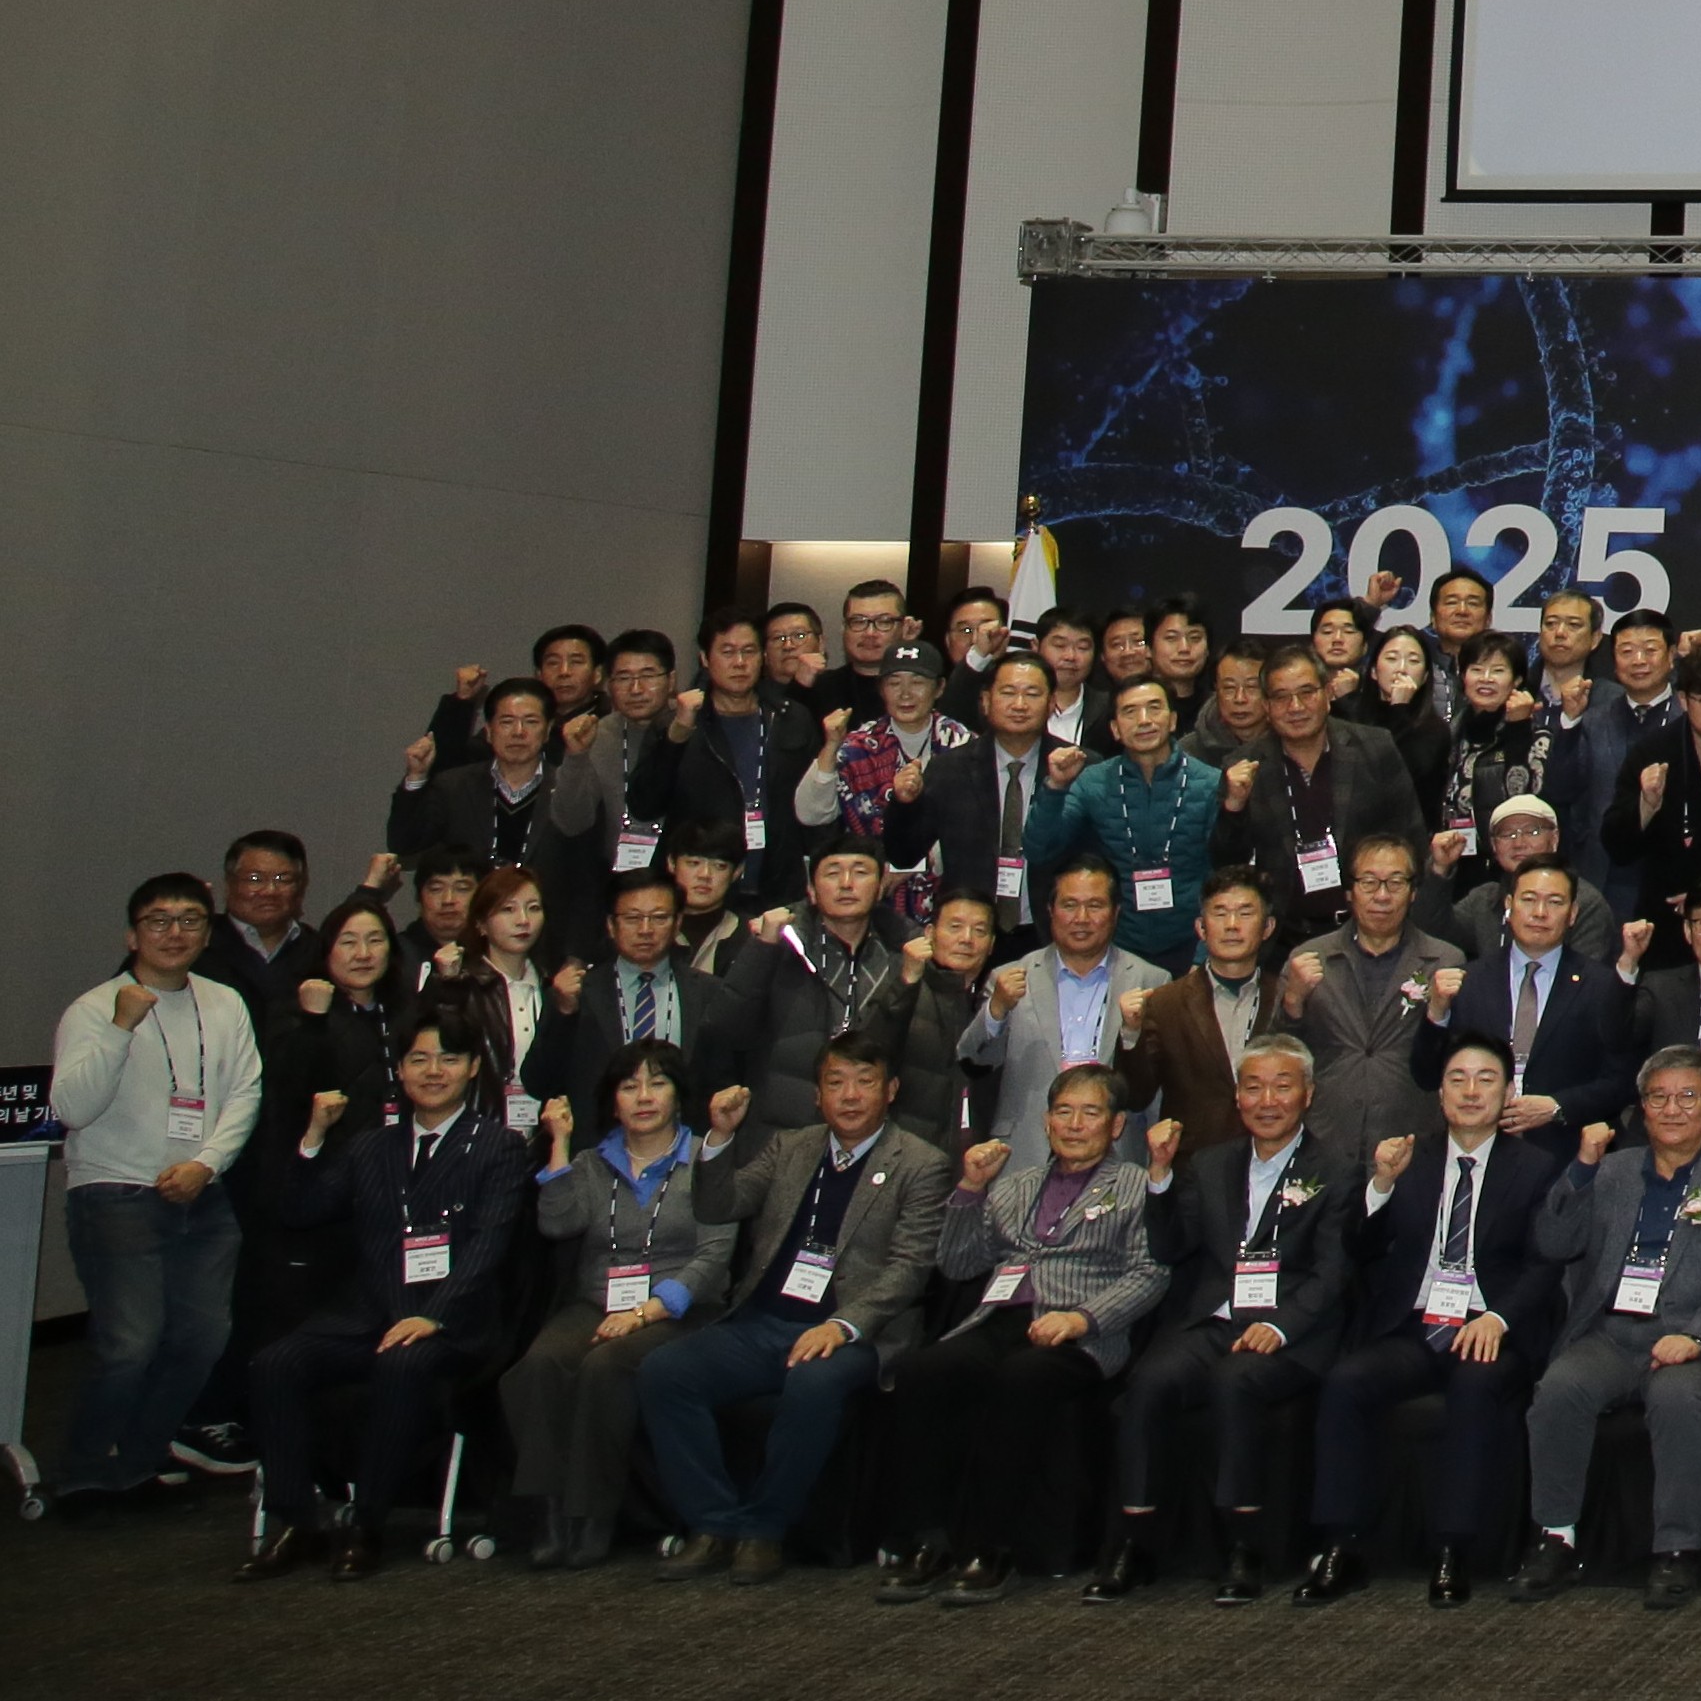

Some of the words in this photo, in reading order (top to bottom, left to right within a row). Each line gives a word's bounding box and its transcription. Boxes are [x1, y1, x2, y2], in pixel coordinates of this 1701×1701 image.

[1240, 503, 1671, 636] 2025
[22, 1083, 38, 1100] 및
[15, 1106, 32, 1123] 날
